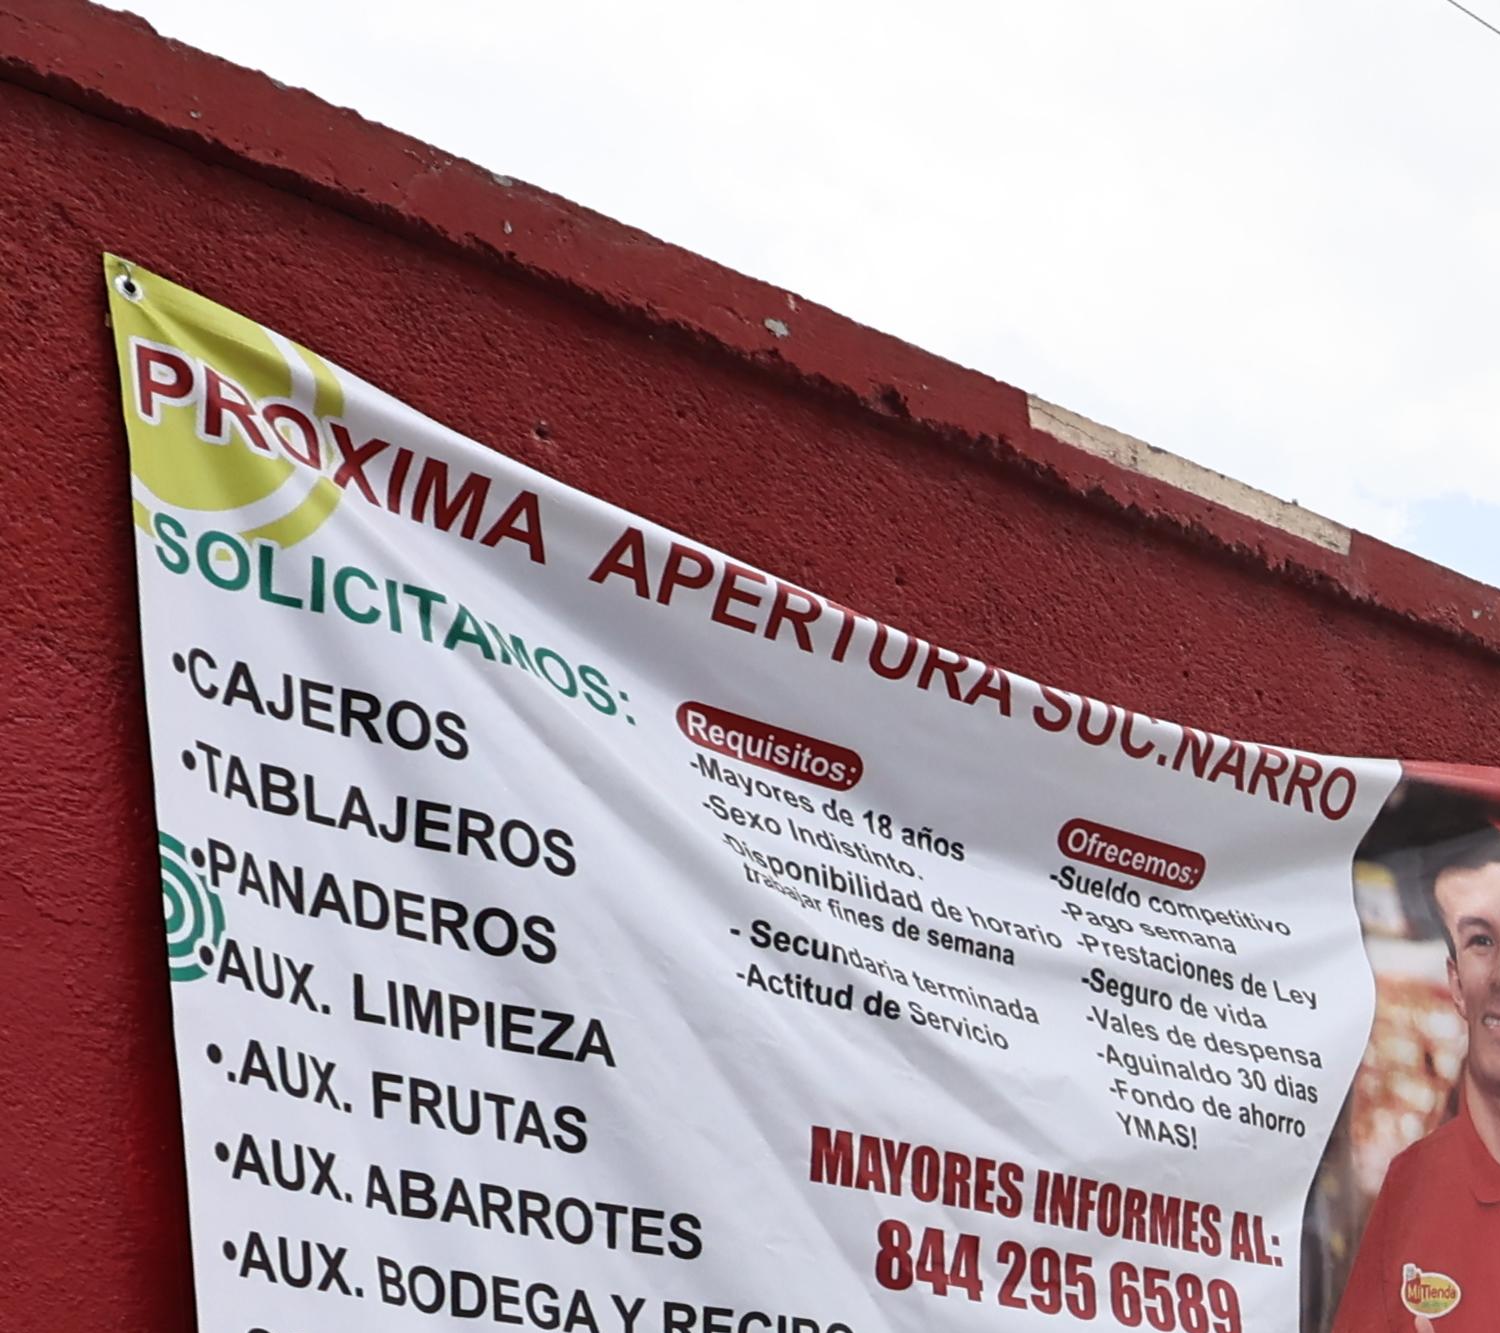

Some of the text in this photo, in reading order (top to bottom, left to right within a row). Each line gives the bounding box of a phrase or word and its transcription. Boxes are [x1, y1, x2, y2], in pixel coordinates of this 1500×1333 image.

[135, 343, 547, 565] PROXIMA
[588, 526, 1012, 718] APERTURA
[153, 512, 637, 727] SOLICITAMOS:
[686, 709, 857, 786] Requisitos:
[789, 818, 924, 880] Indistinto.
[822, 799, 854, 827] de
[863, 810, 892, 839] 18
[902, 827, 965, 862] años
[1067, 827, 1199, 886] Ofrecemos:
[744, 863, 1015, 966] trabajar fines de semana
[931, 896, 962, 923] de
[968, 906, 1063, 949] horario
[1139, 921, 1236, 954] semana
[1148, 895, 1291, 936] competitivo
[750, 919, 909, 987] Secundaria
[913, 970, 1040, 1025] terminada
[1241, 973, 1267, 998] de
[1273, 980, 1317, 1010] Ley
[352, 972, 618, 1068] LIMPIEZA
[864, 991, 900, 1020] de
[910, 1002, 1009, 1050] Servicio
[1180, 994, 1208, 1018] de
[1214, 1004, 1267, 1029] vida
[1166, 1025, 1196, 1048] de
[1204, 1032, 1322, 1069] despensa
[371, 1070, 588, 1154] FRUTAS
[1202, 1096, 1231, 1120] de
[1239, 1103, 1306, 1137] ahorro
[1237, 1067, 1267, 1092] 30
[1274, 1075, 1318, 1104] dias
[1116, 1111, 1198, 1150] YMAS!
[365, 1164, 703, 1260] ABARROTES
[809, 1125, 1283, 1267] MAYORES INFORMES AL:
[875, 1219, 983, 1302] 844
[997, 1240, 1096, 1321] 295
